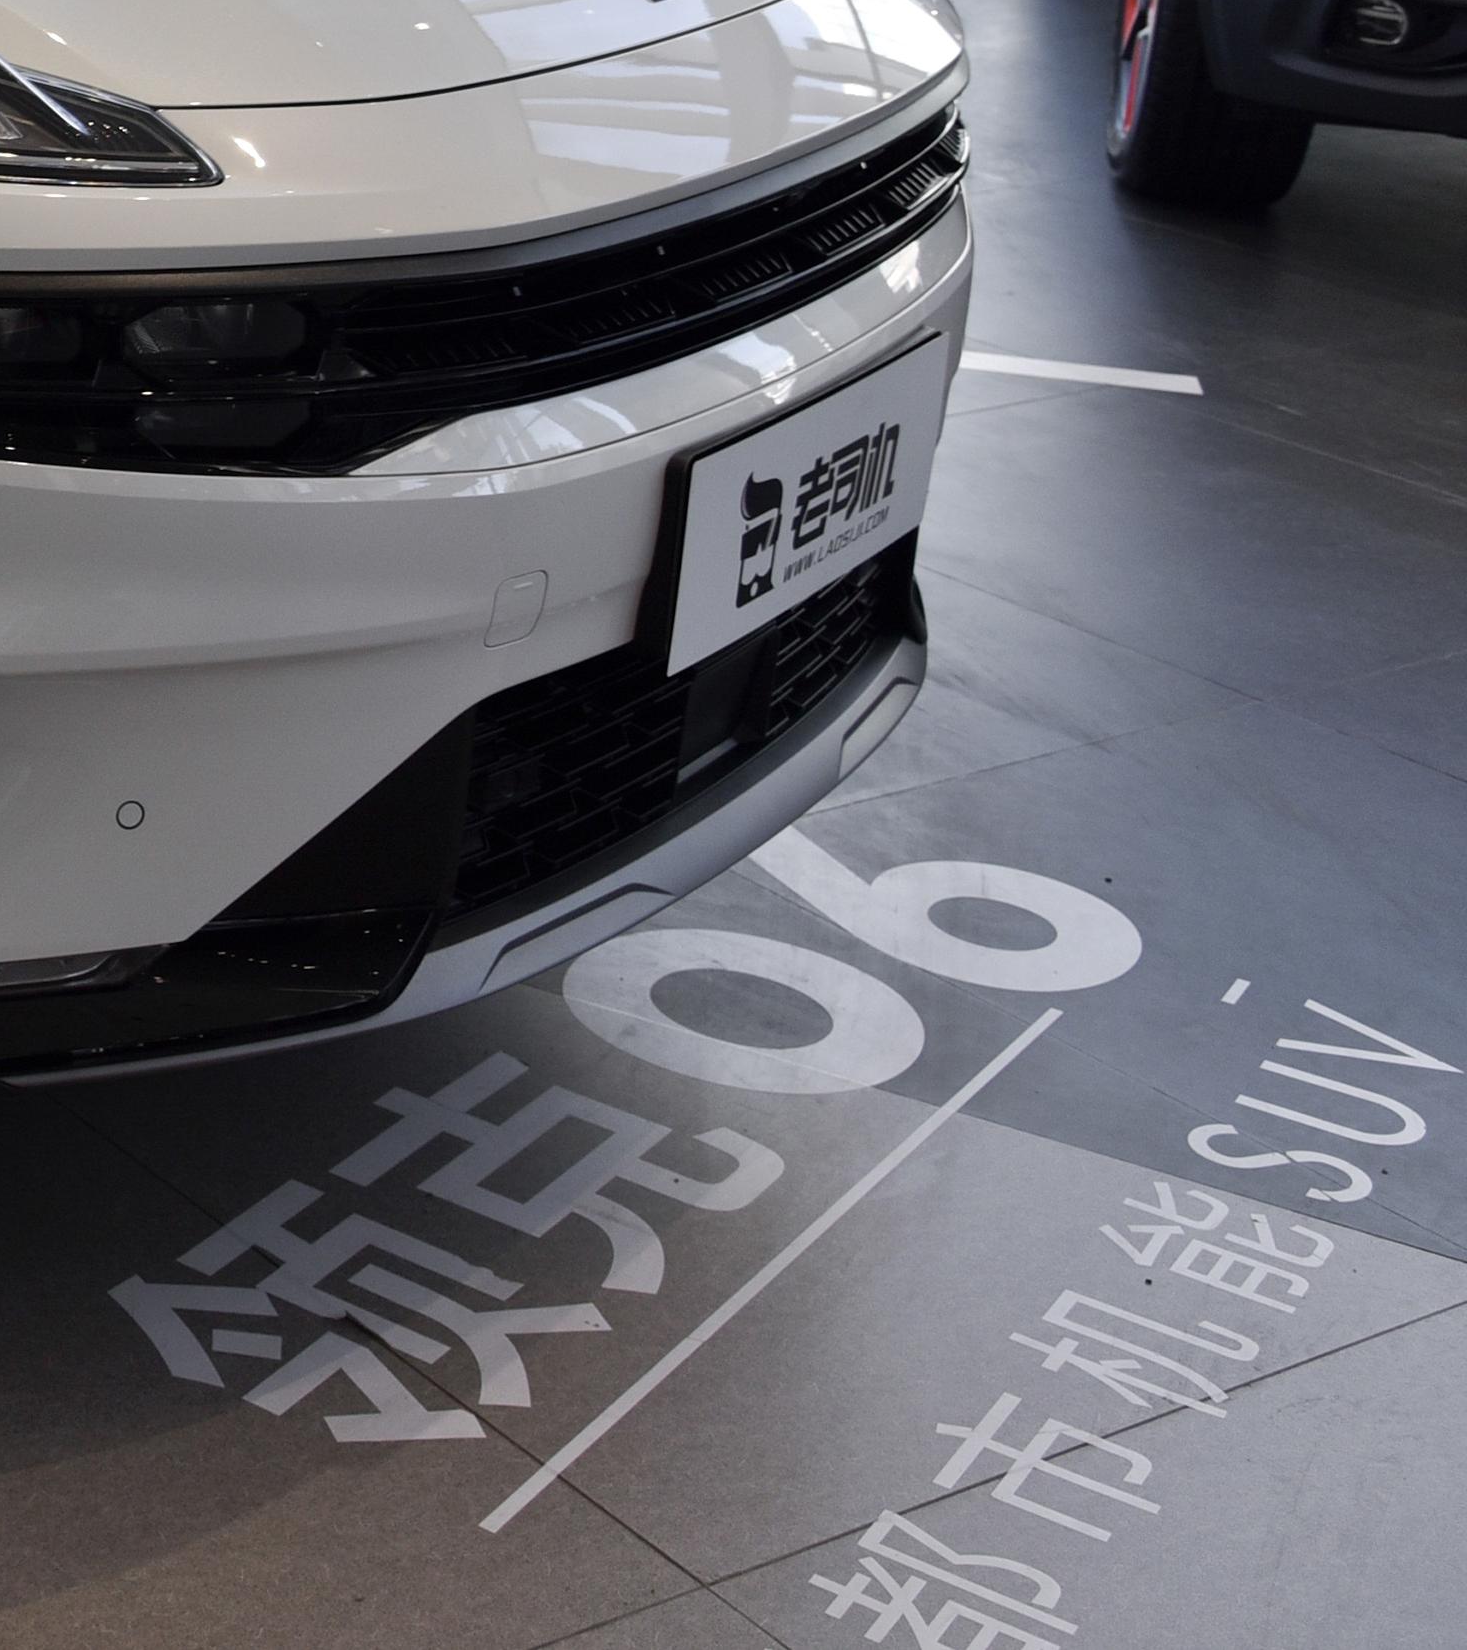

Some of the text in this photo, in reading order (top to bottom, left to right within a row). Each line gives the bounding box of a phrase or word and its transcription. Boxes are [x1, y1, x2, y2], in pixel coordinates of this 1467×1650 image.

[790, 421, 900, 551] 老司机
[782, 505, 890, 583] WWW.LAOSIJI.COM
